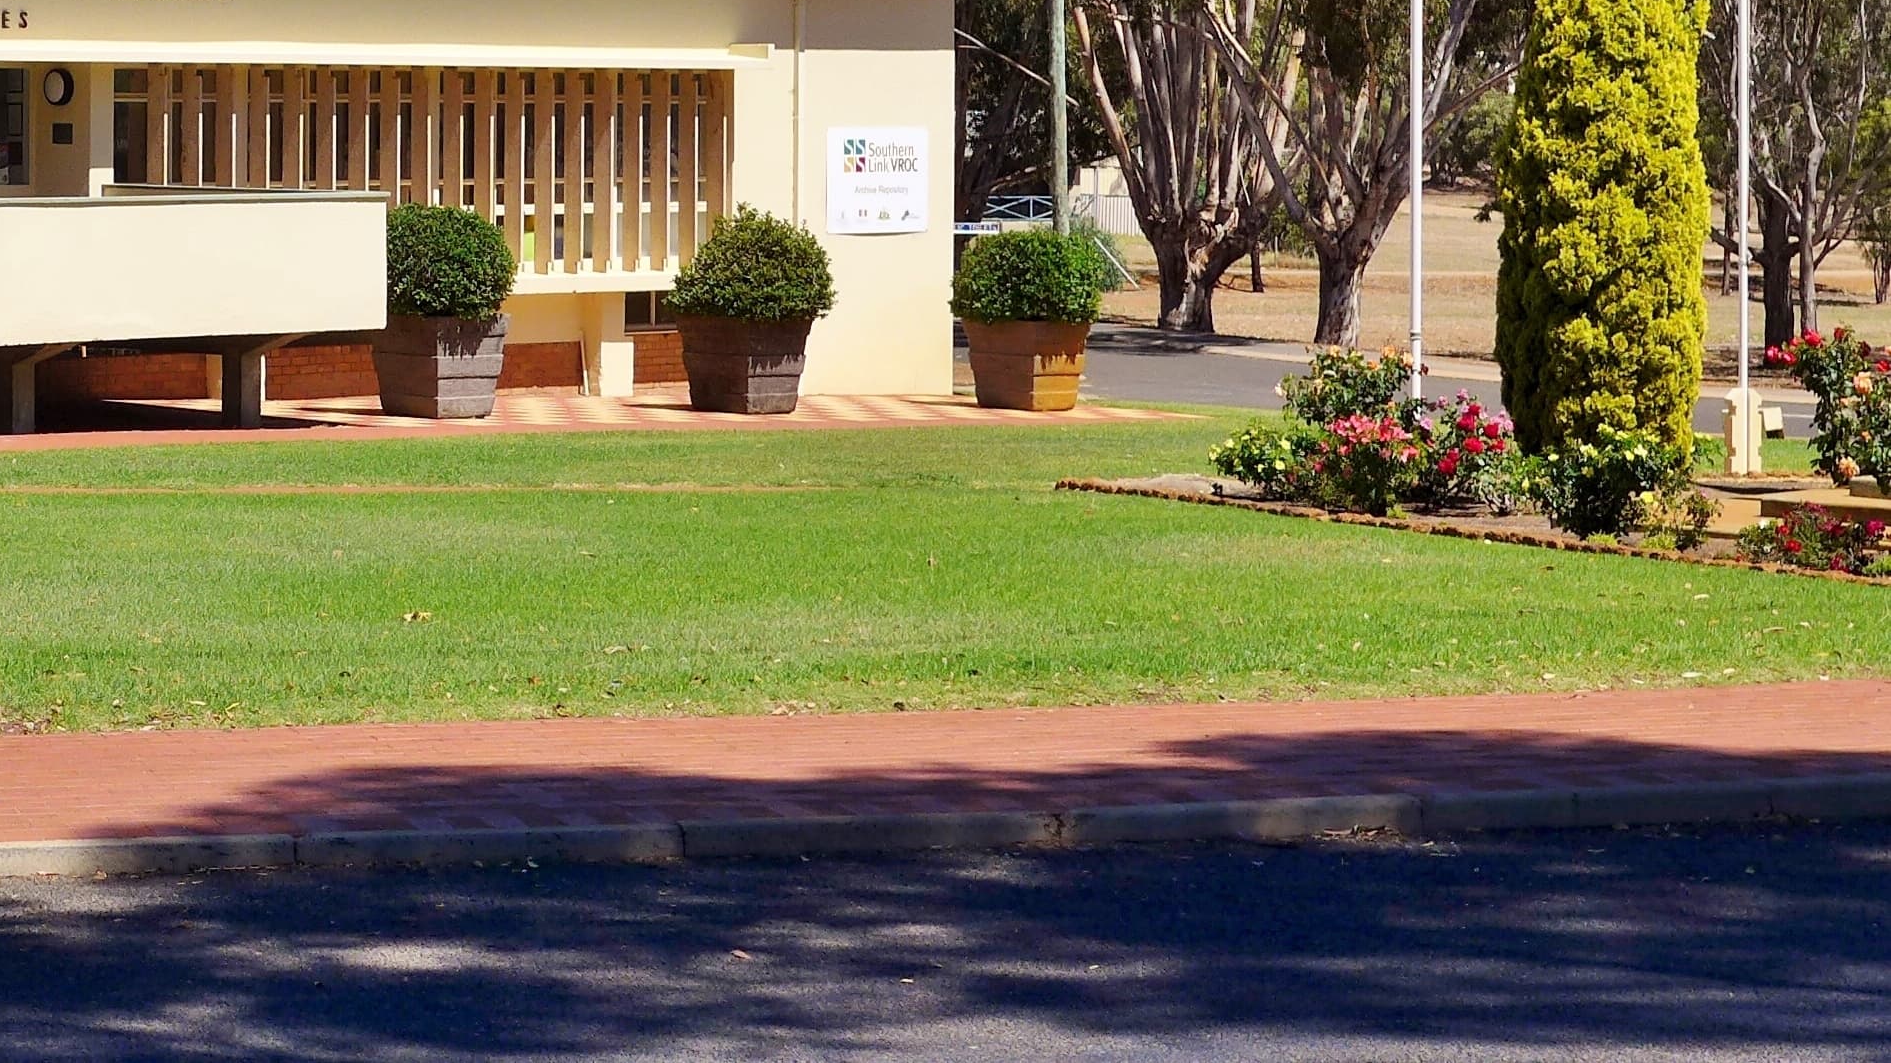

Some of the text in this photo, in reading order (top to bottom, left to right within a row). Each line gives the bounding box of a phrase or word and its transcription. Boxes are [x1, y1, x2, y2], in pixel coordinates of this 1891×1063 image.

[868, 142, 914, 157] Southern
[868, 158, 918, 173] Link VROC
